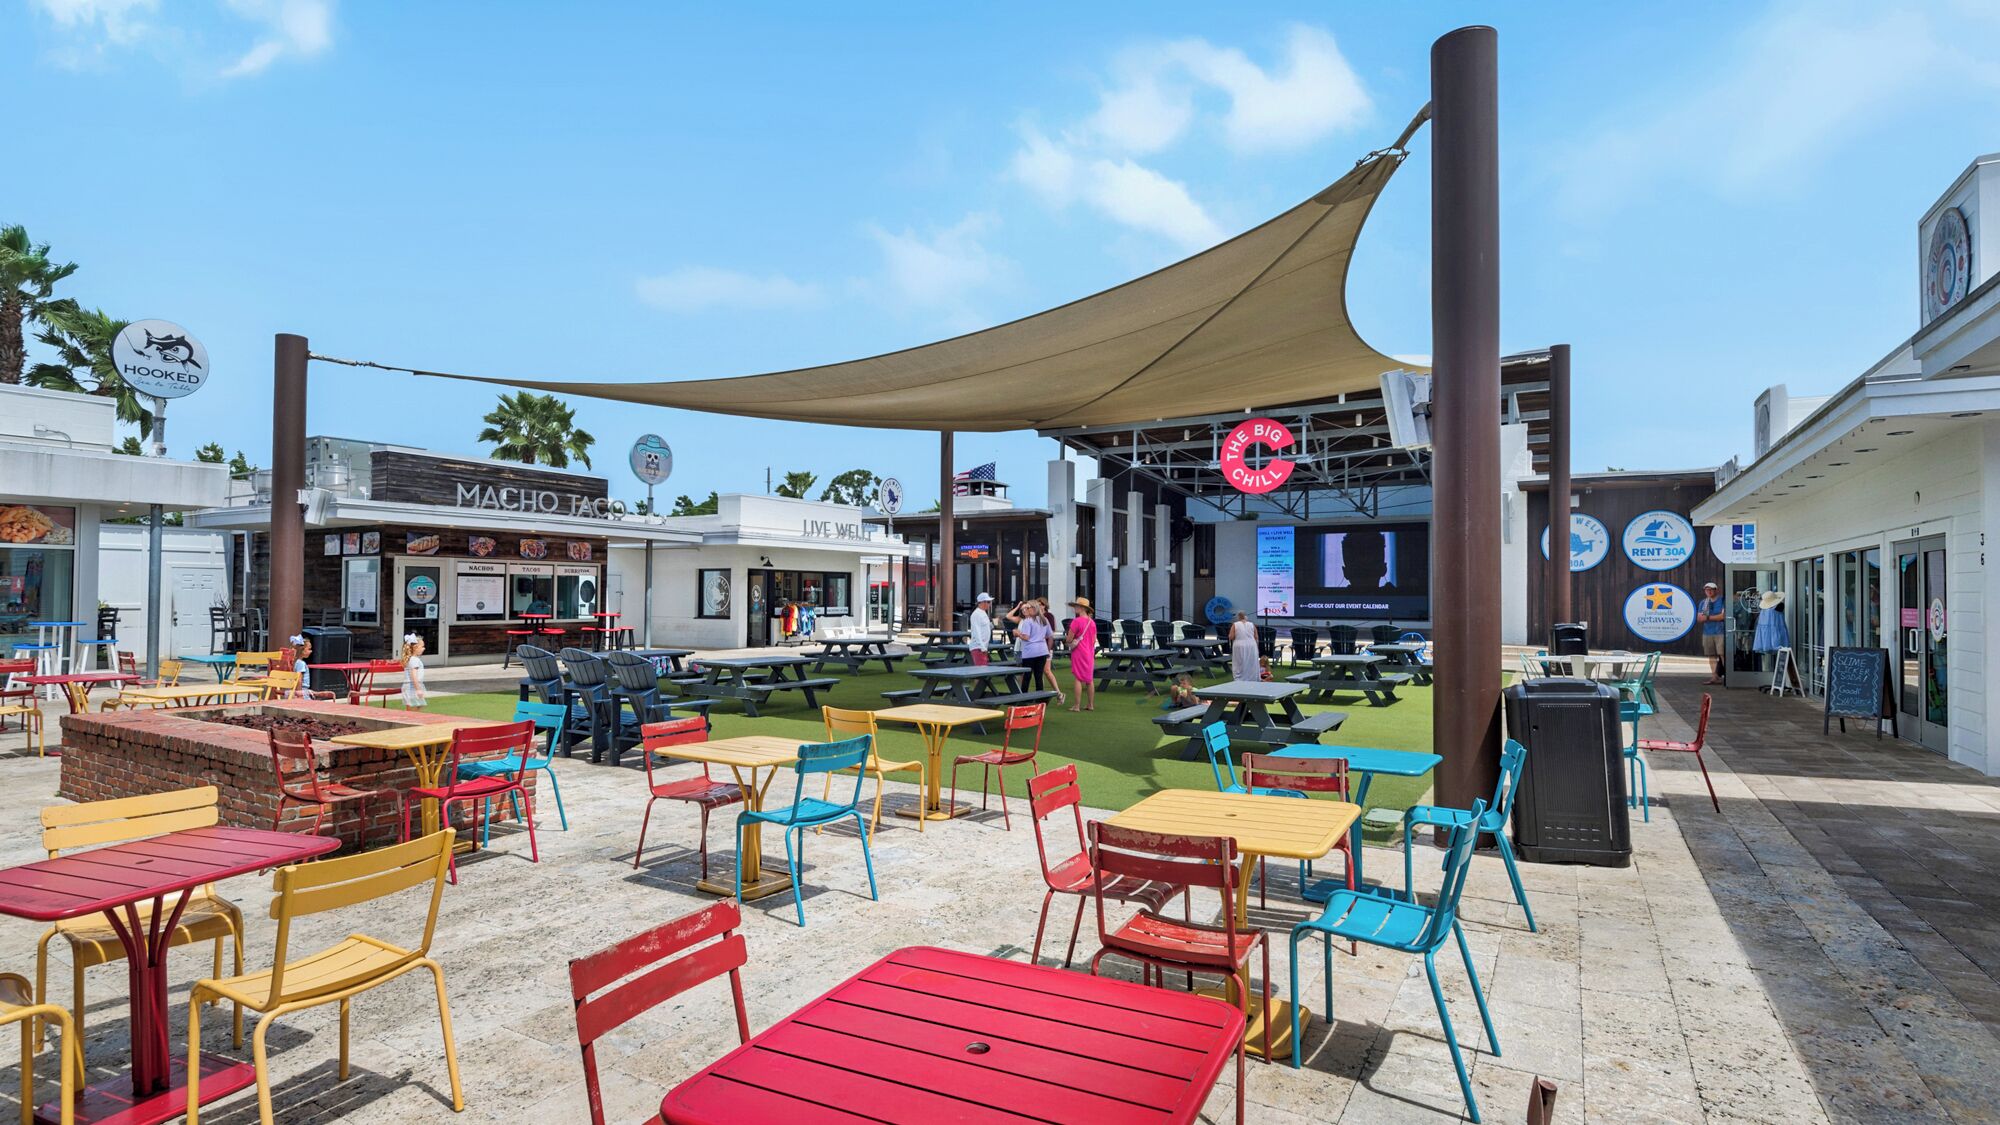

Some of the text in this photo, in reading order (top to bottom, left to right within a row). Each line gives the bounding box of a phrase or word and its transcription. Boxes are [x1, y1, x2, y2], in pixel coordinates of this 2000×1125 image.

[124, 364, 200, 384] HOOKED
[1226, 424, 1282, 461] THE BIG
[1232, 468, 1282, 487] CHILL
[456, 482, 627, 519] MACHO TACO
[802, 519, 872, 541] LIVE WELL
[1576, 517, 1602, 535] WELL
[1733, 533, 1755, 545] 85
[1632, 547, 1687, 557] RENT 30A
[1637, 615, 1682, 626] getaways
[1837, 656, 1867, 668] SLIME
